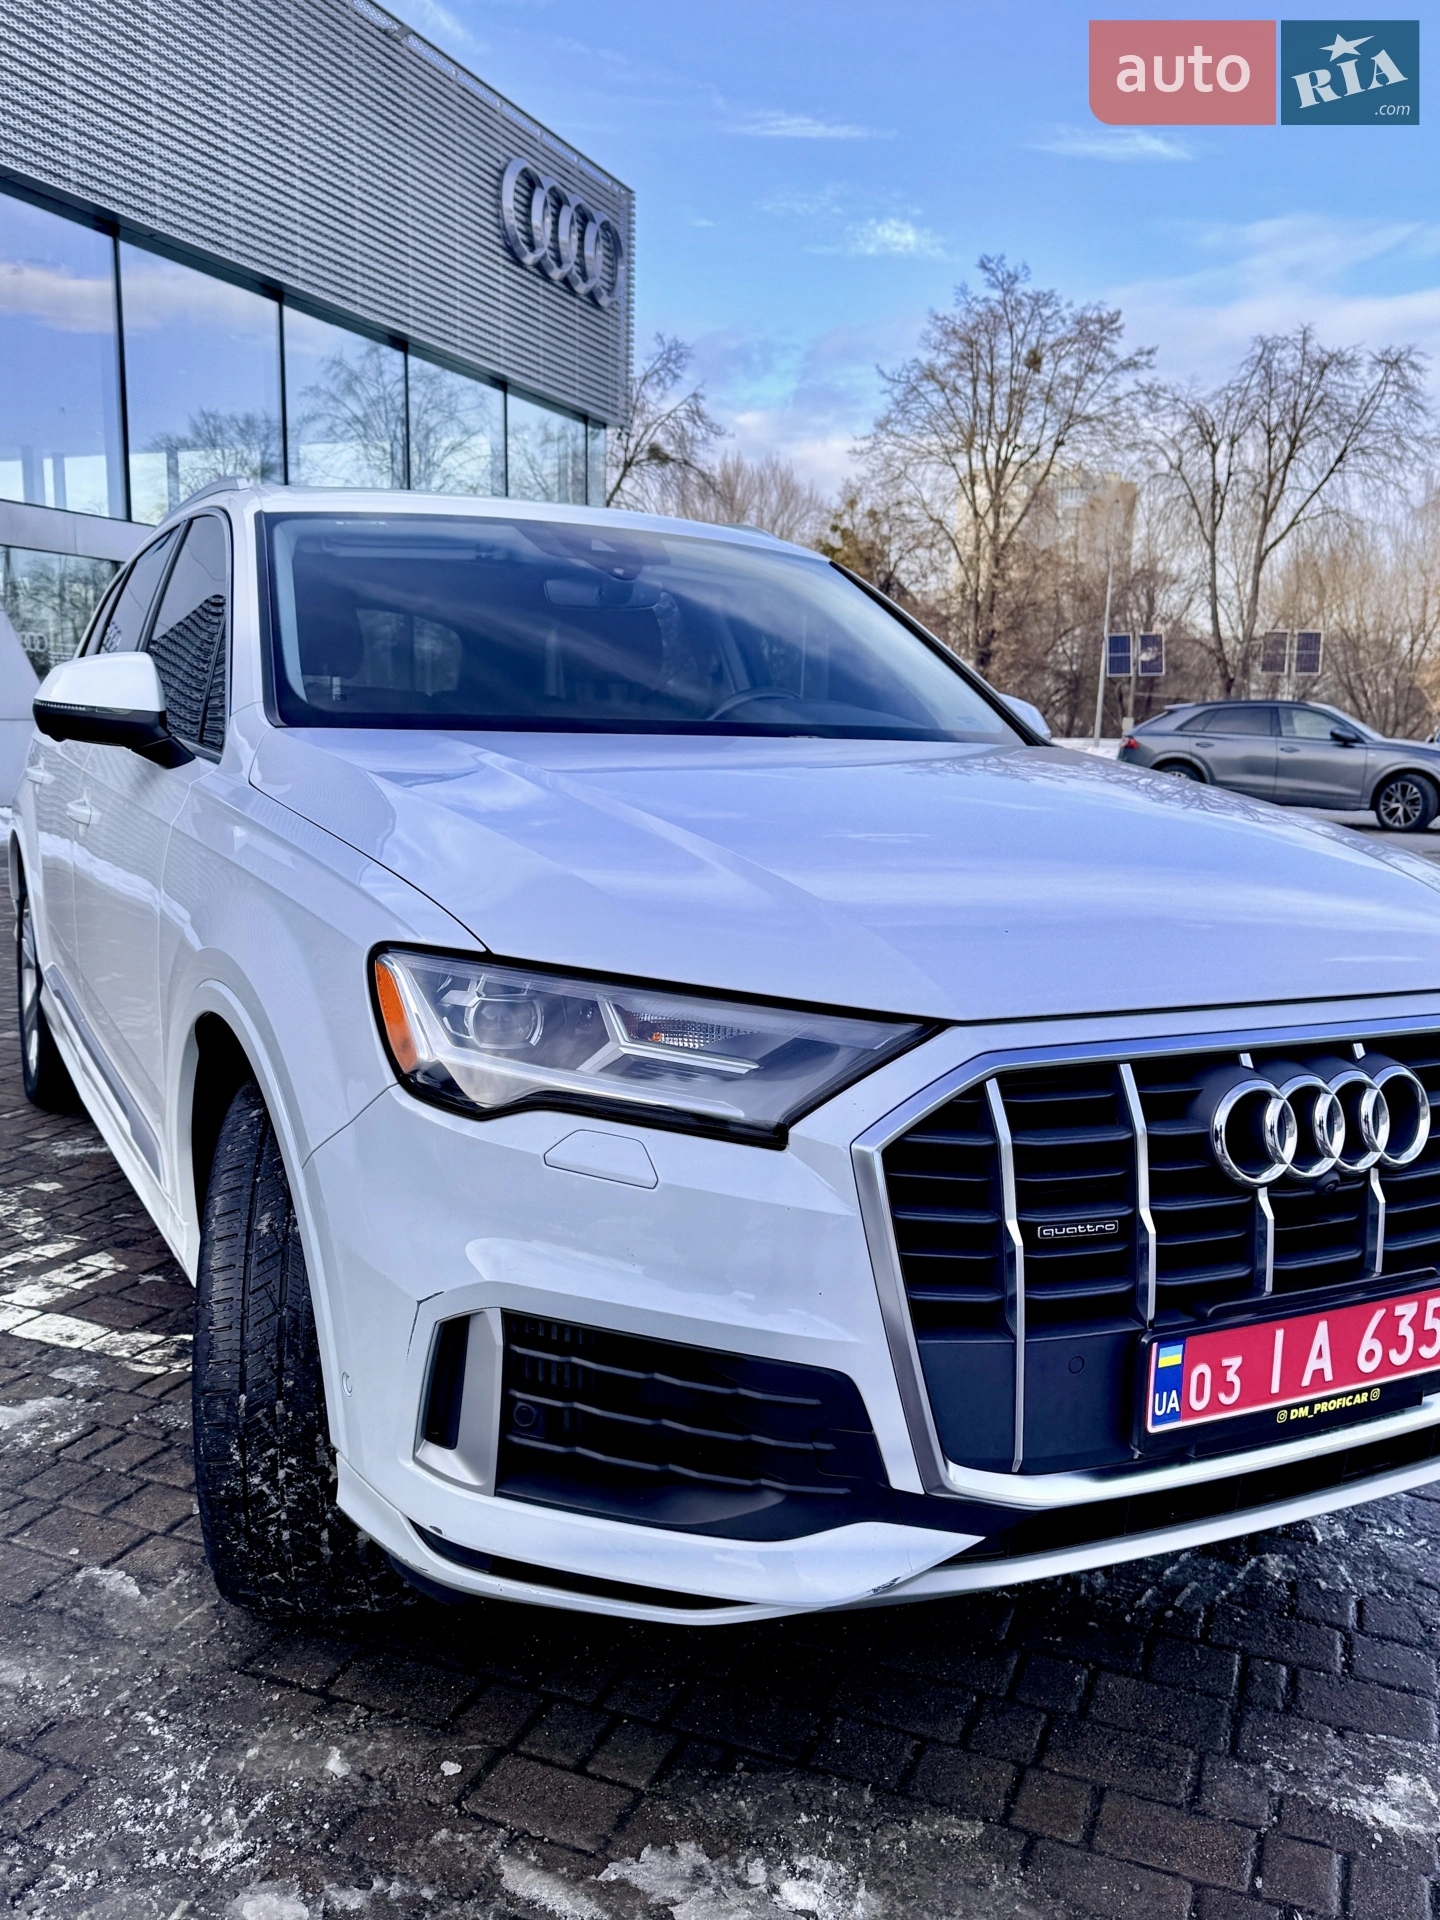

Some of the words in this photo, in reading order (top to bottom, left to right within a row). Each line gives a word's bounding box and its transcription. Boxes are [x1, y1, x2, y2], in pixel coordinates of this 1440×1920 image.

[1042, 1223, 1116, 1237] quattro
[1154, 1389, 1180, 1416] UA
[1188, 1355, 1243, 1411] 03
[1356, 1297, 1440, 1374] 635
[1289, 1391, 1369, 1420] DM_PROFICAR
